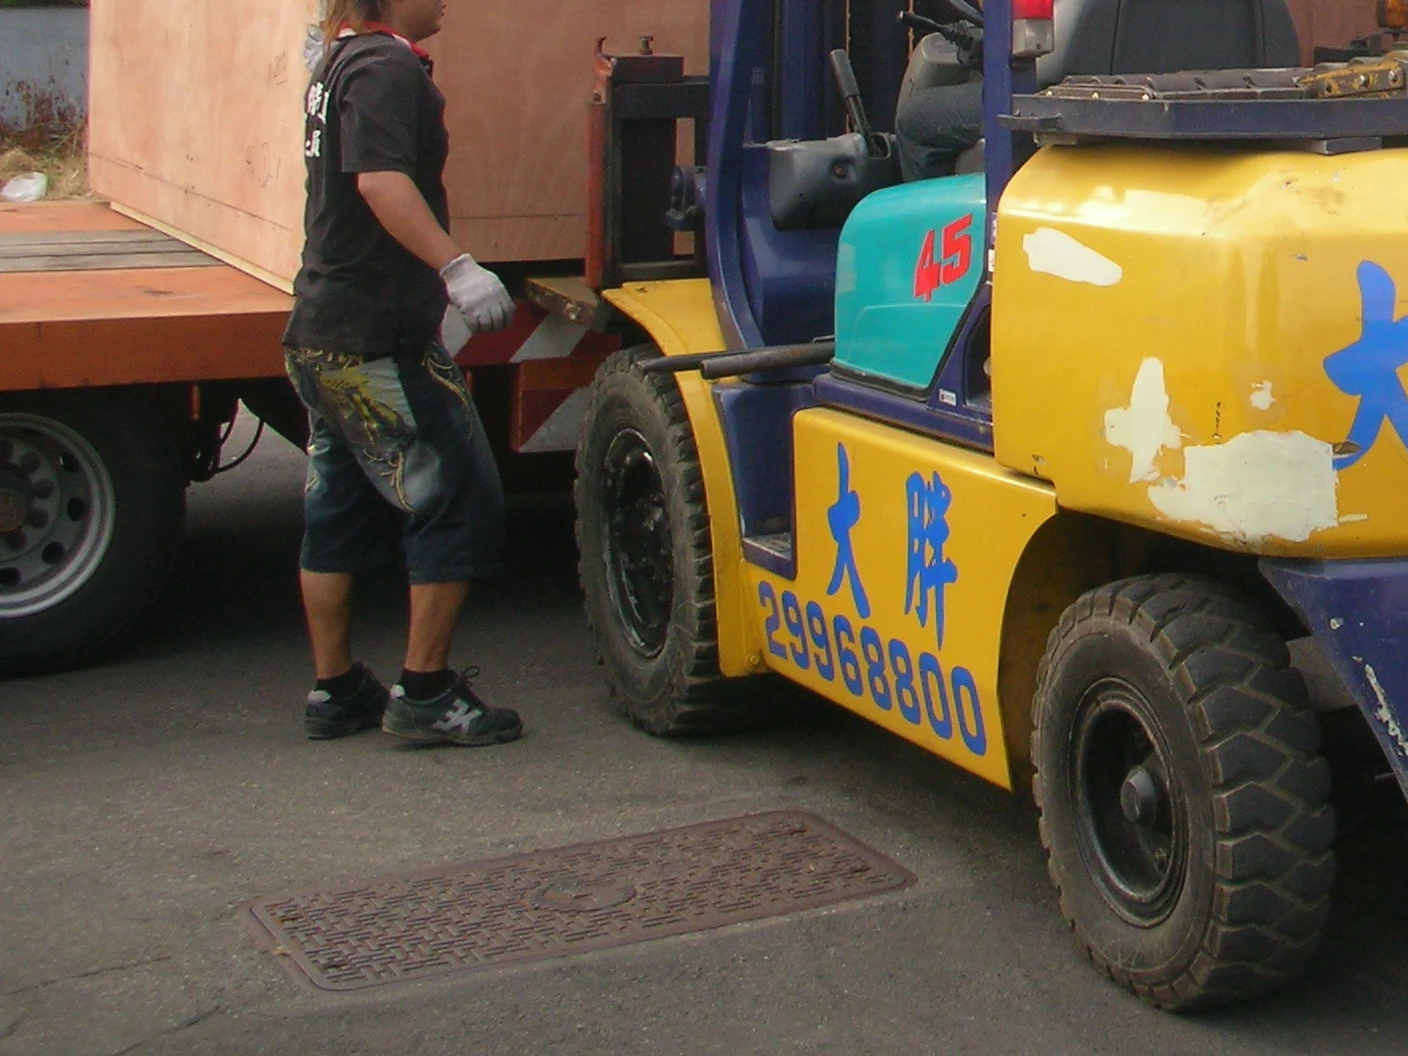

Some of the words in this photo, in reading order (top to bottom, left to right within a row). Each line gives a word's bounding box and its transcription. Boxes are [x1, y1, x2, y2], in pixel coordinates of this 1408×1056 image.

[914, 213, 973, 302] 45
[826, 442, 958, 651] 大胖
[758, 581, 987, 756] 29968800
